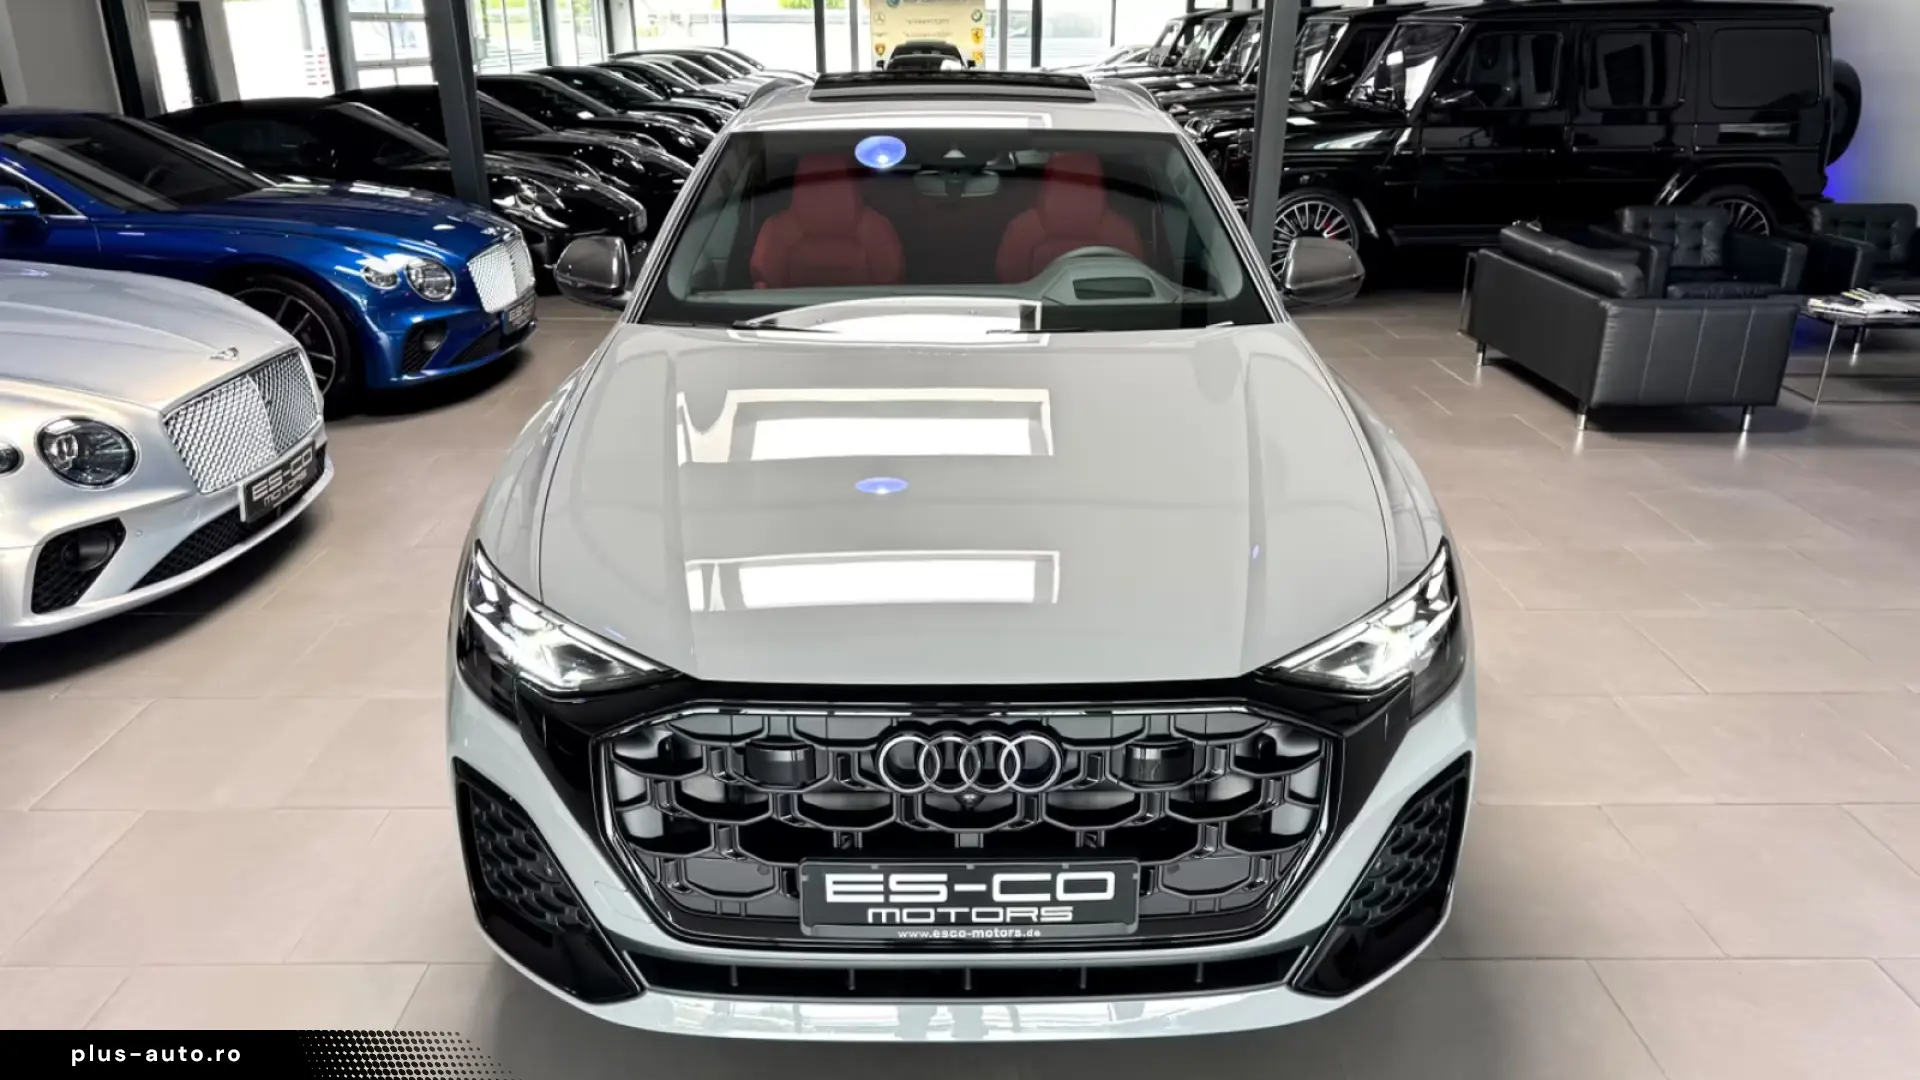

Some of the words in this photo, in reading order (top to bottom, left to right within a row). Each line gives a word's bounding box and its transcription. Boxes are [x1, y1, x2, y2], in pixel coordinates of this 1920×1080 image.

[252, 446, 313, 502] ES-CO
[825, 871, 1116, 903] ES-CO
[867, 906, 1074, 924] MOTORS
[897, 928, 1042, 939] www.esco-motors.de
